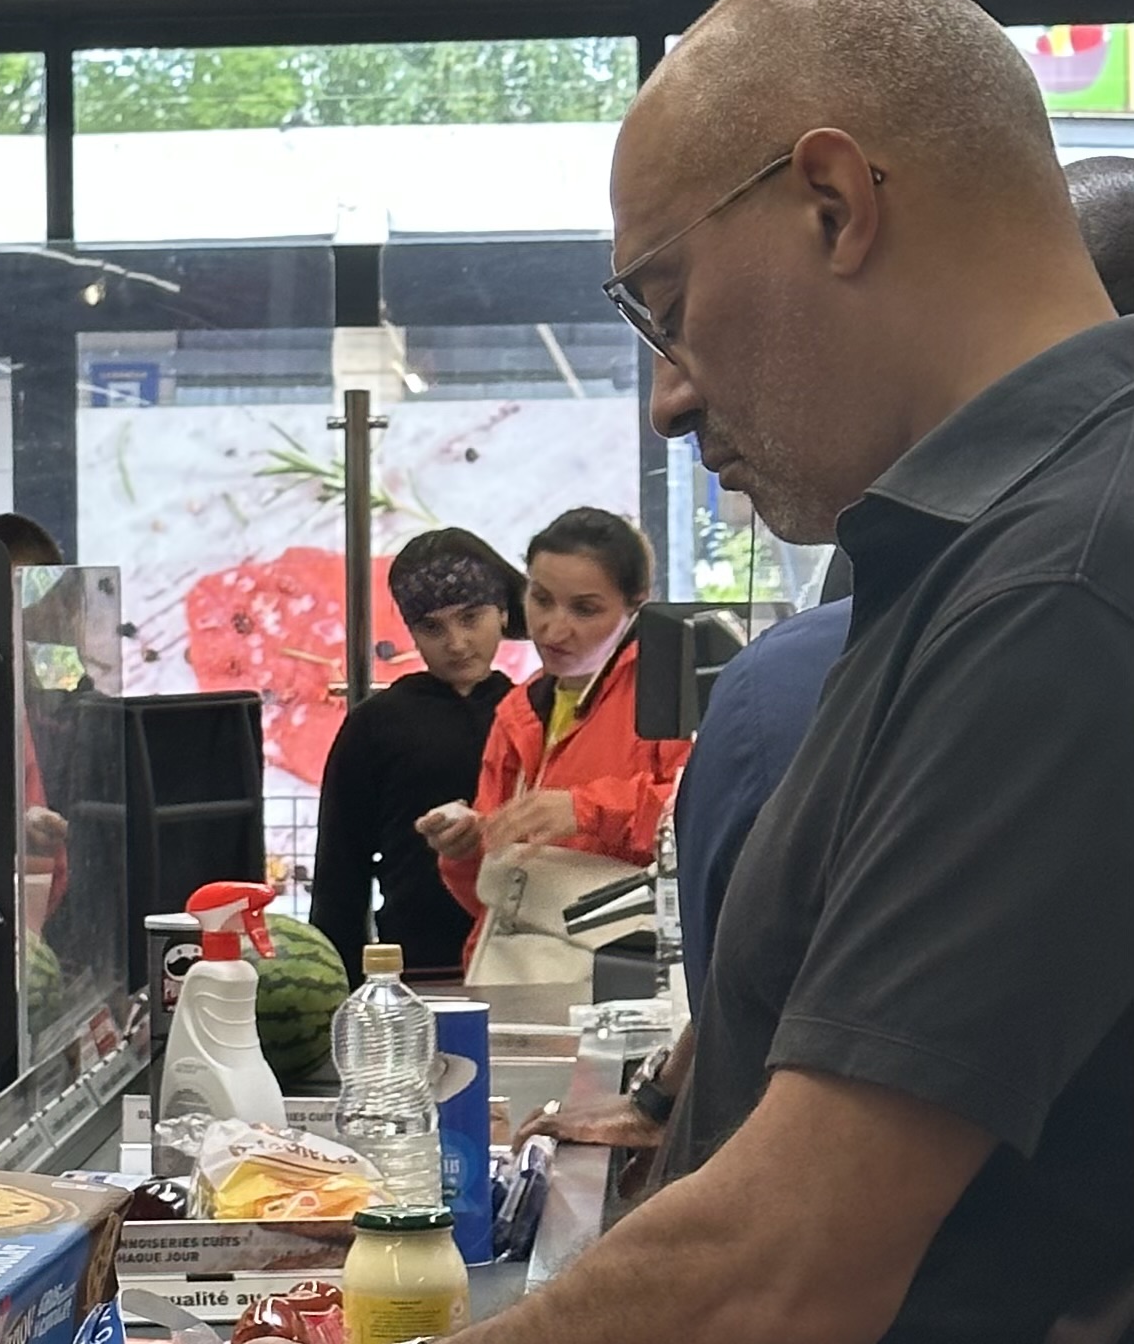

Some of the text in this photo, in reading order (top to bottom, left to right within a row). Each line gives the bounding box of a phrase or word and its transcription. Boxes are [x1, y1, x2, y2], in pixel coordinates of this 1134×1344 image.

[202, 1236, 241, 1248] CUITS
[165, 1251, 200, 1262] JOUR
[166, 1291, 229, 1306] ualité
